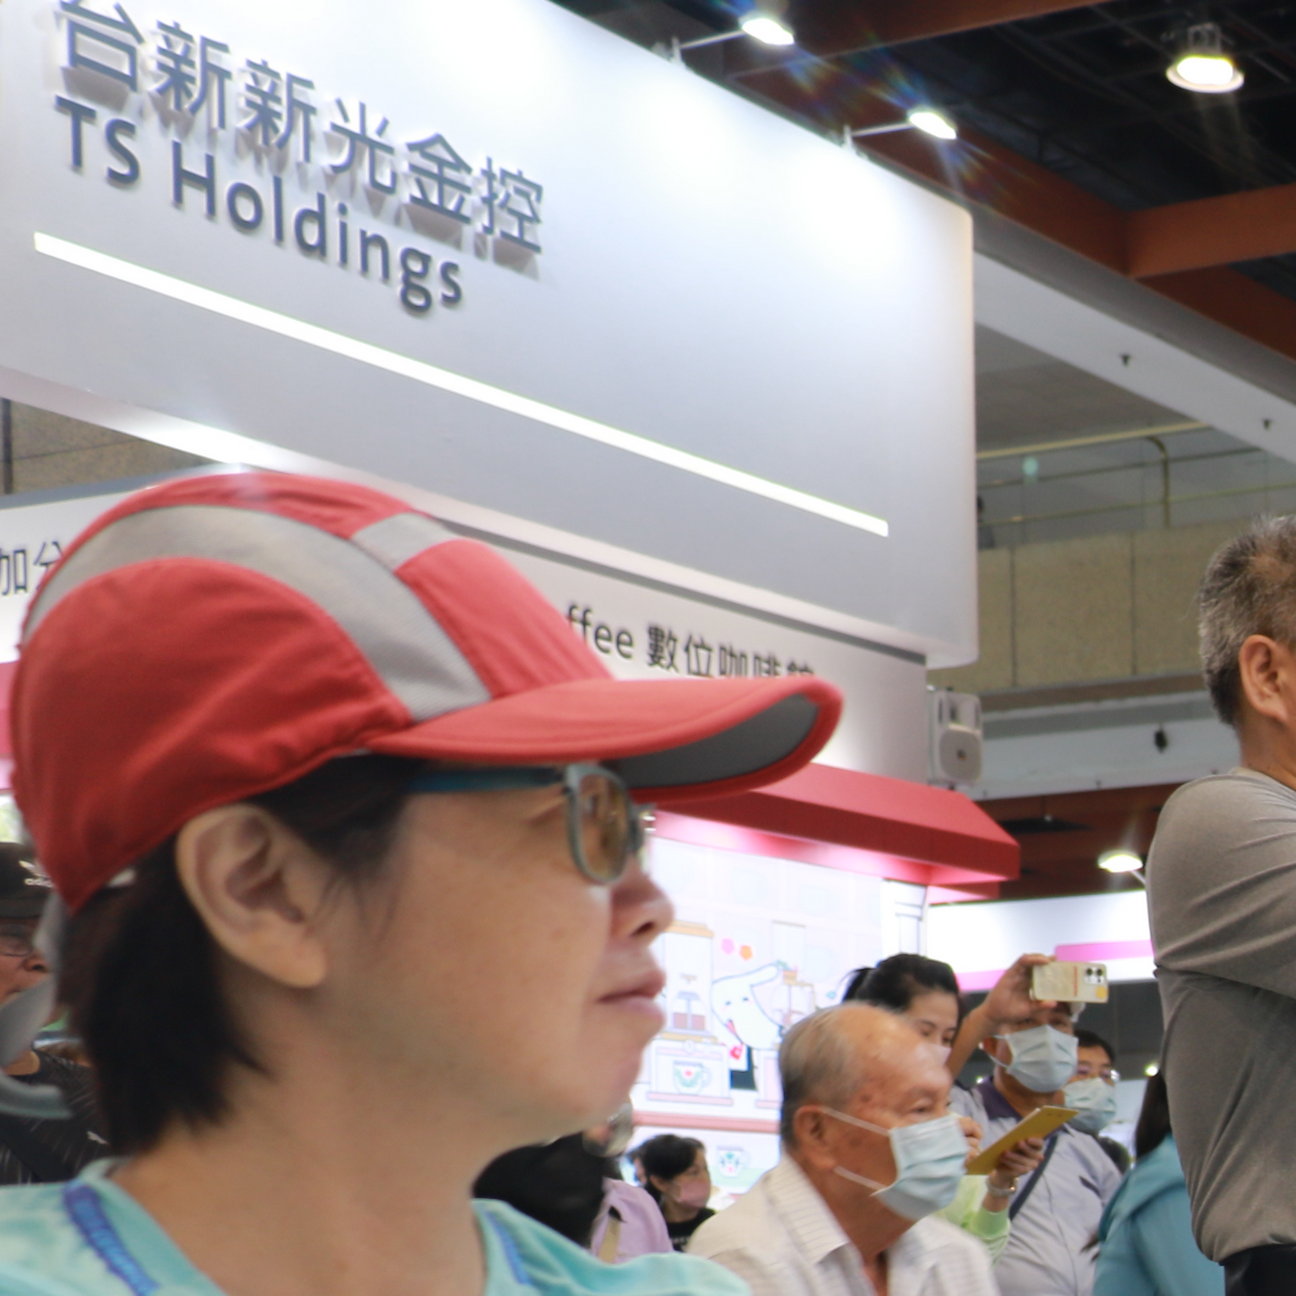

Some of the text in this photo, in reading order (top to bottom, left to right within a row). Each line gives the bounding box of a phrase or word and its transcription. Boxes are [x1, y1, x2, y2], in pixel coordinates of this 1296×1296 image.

[55, 95, 464, 313] TS Holdings
[59, 0, 544, 254] 台新新光金控
